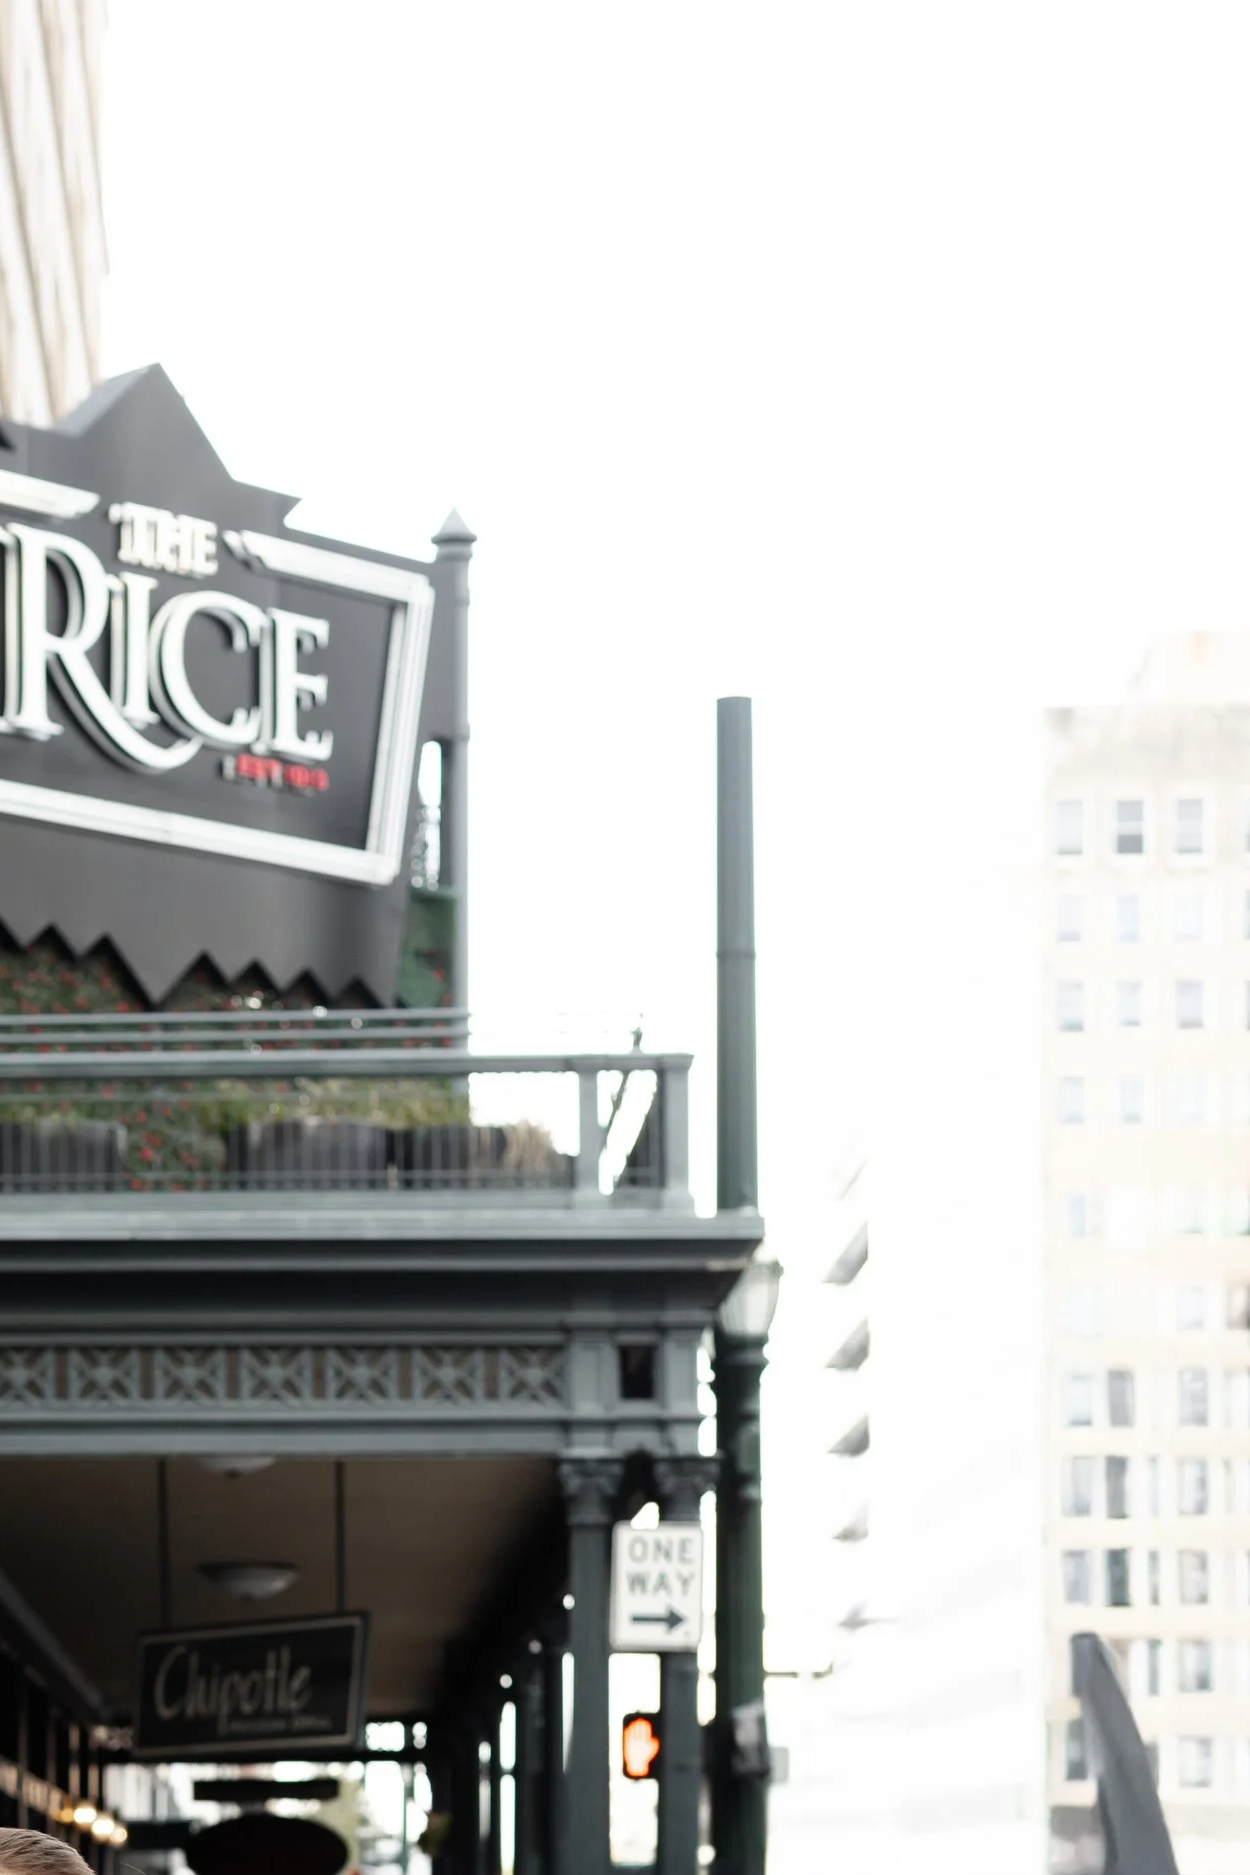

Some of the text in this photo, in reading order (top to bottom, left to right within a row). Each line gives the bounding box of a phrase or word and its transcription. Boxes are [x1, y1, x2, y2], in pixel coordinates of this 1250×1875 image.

[110, 502, 219, 577] THE
[627, 1536, 695, 1565] ONE
[625, 1570, 696, 1597] WAY
[154, 1643, 313, 1737] Chipotle
